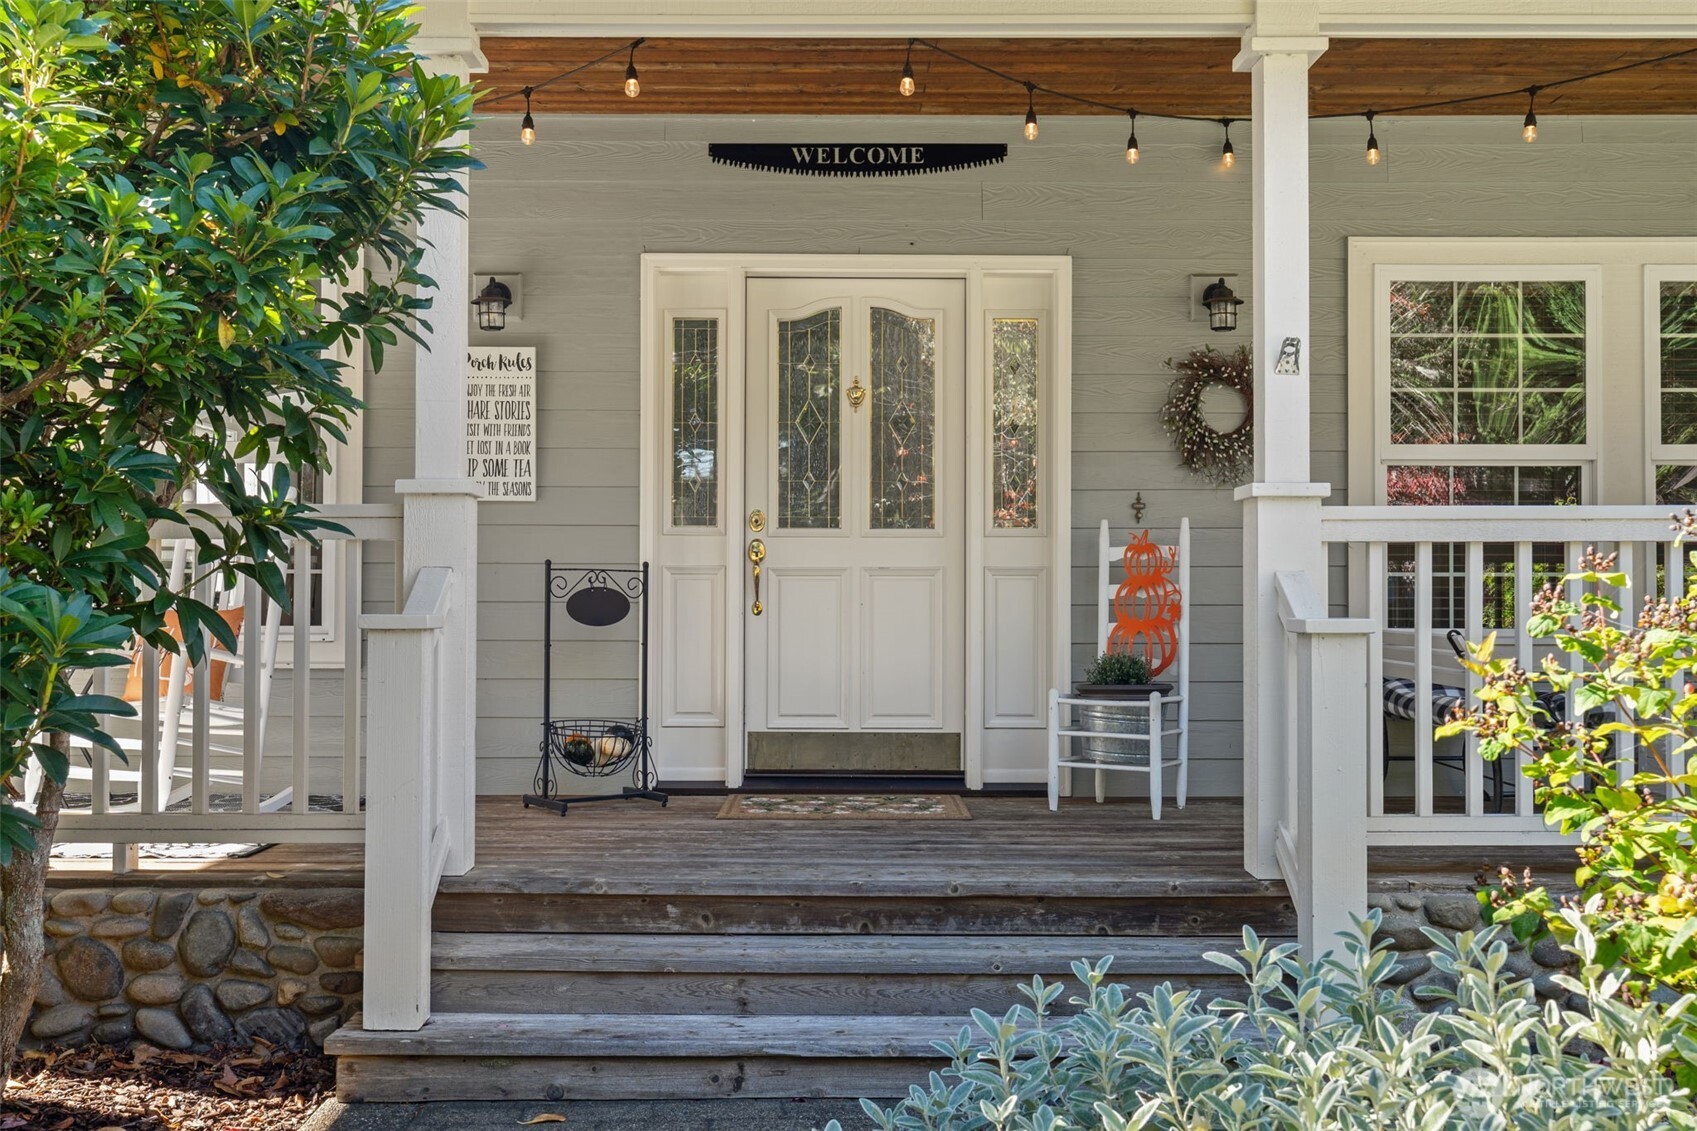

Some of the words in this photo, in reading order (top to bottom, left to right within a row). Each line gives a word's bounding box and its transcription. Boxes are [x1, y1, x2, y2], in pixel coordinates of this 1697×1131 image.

[791, 146, 925, 165] WELCOME
[499, 351, 532, 372] Rules
[467, 383, 483, 397] JOY
[485, 383, 496, 397] THE
[498, 383, 517, 397] FRESH
[519, 383, 531, 397] AIR
[467, 399, 491, 420] HARE
[494, 400, 531, 421] STORIES
[466, 423, 480, 437] ISIT
[483, 423, 502, 437] WITH
[503, 423, 531, 437] FRIENDS
[466, 440, 475, 455] ET
[477, 440, 492, 455] LOST
[495, 440, 504, 455] IN
[506, 440, 511, 455] A
[513, 440, 532, 455] BOOK
[467, 458, 479, 477] IP
[482, 458, 509, 478] SOME
[513, 458, 532, 478] TEA
[488, 481, 500, 496] THE
[502, 481, 532, 496] SEASONS
